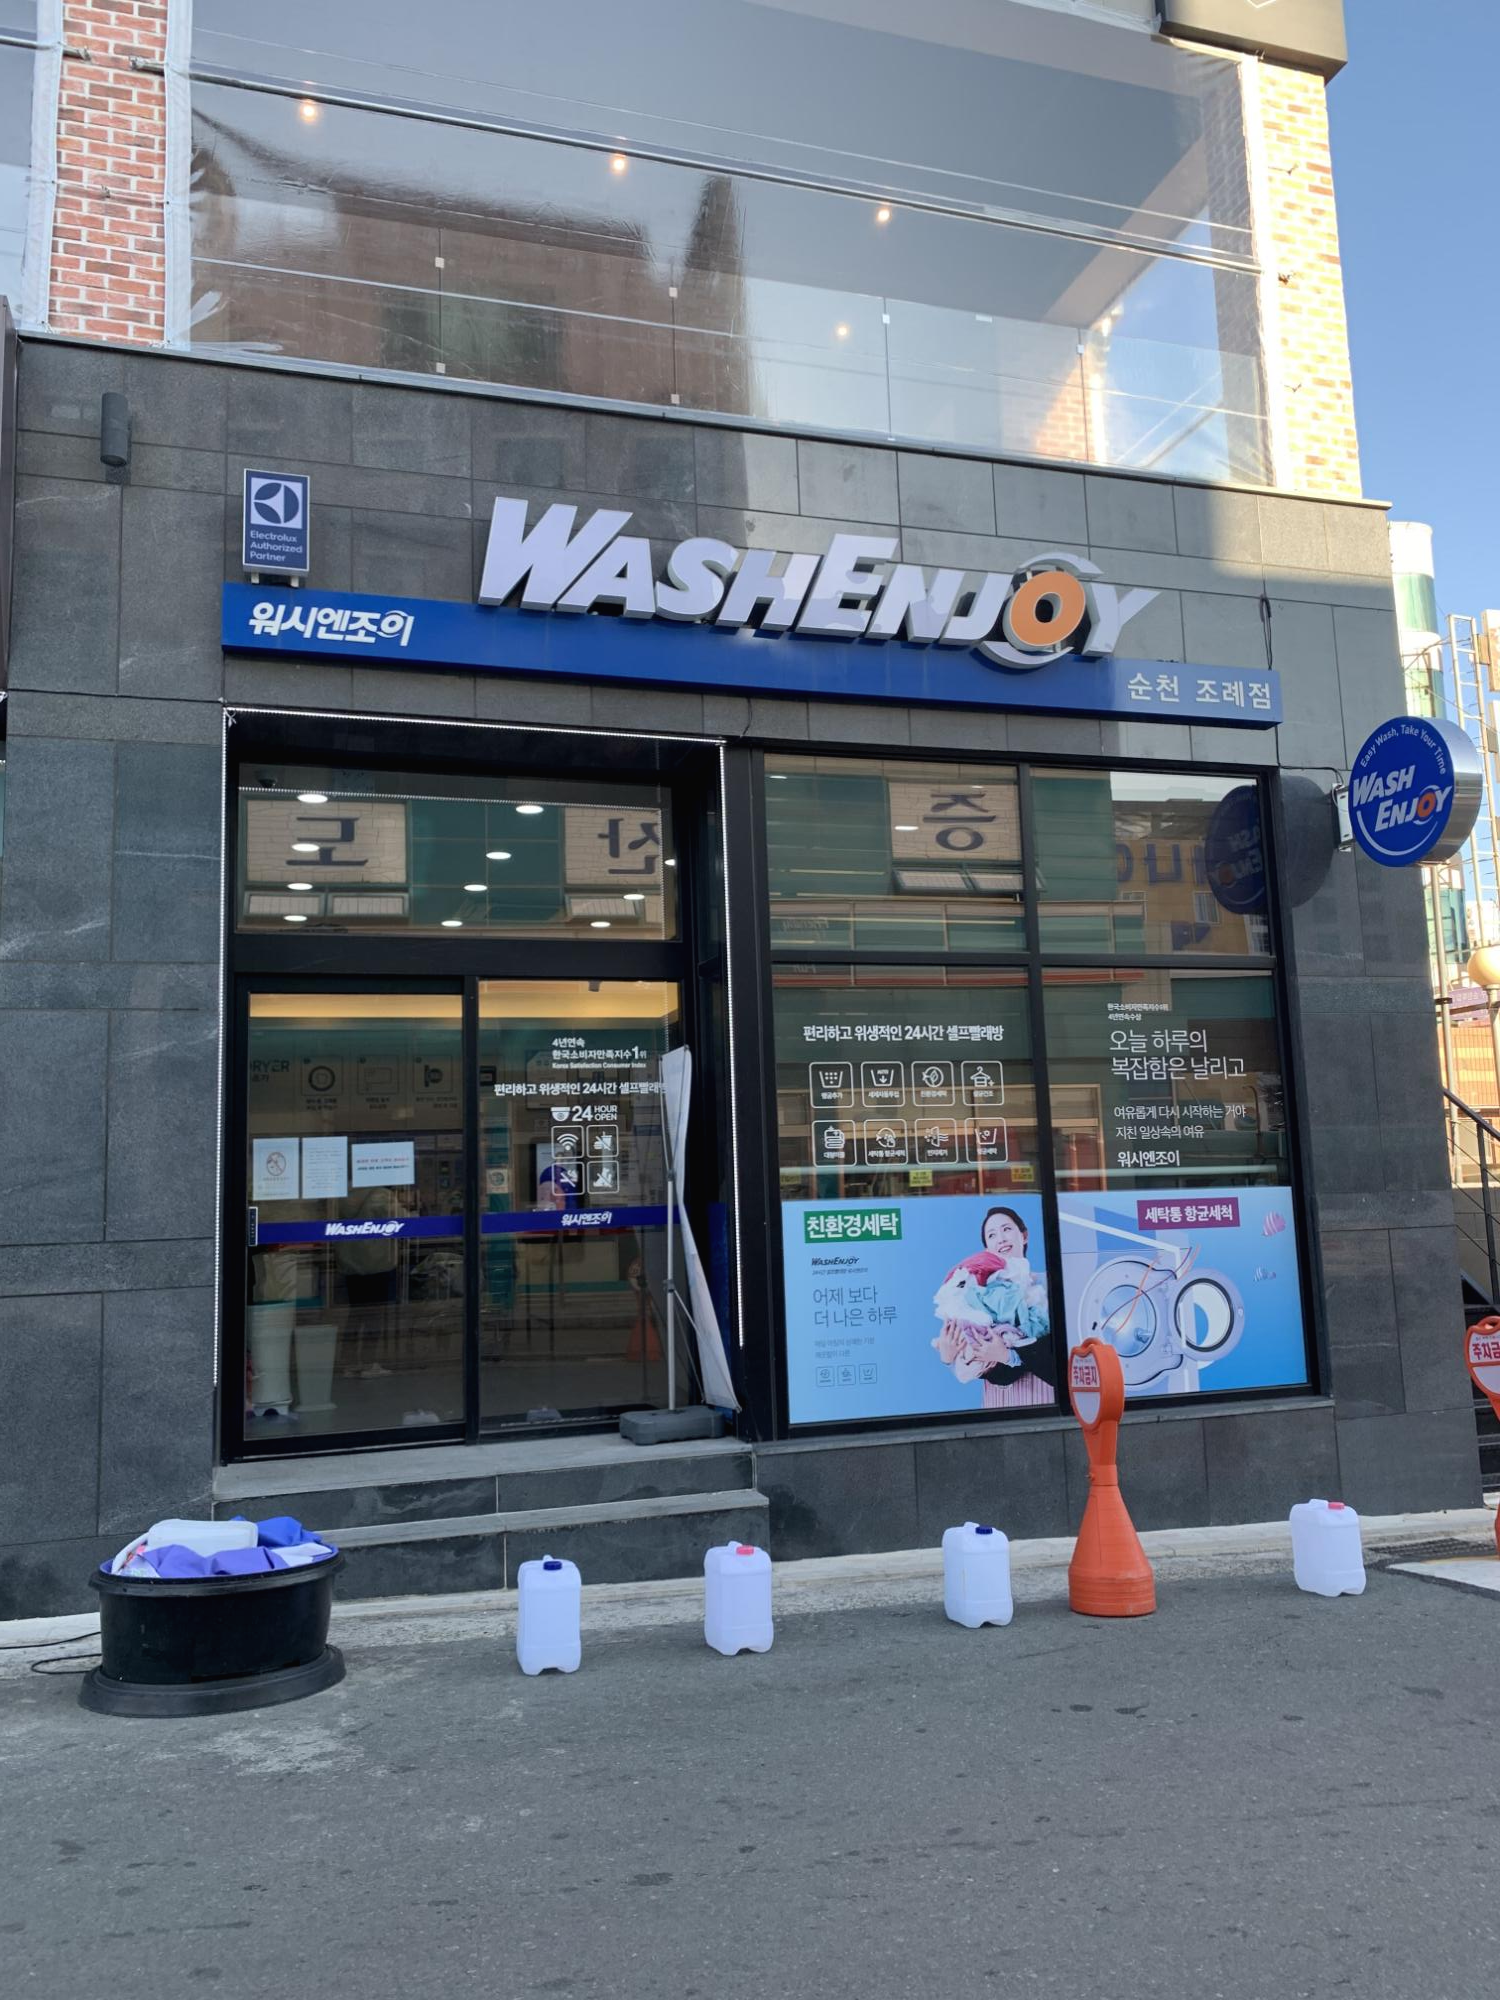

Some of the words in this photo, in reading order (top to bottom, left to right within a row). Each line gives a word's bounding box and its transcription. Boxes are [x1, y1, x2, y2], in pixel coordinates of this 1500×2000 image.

[250, 530, 297, 543] Electrolux
[250, 541, 303, 554] Authorized
[250, 550, 286, 562] Partner
[248, 602, 415, 647] 워시엔조이
[1127, 672, 1181, 704] 순천
[1195, 676, 1272, 711] 조례점
[1360, 744, 1377, 768] Easy
[1374, 727, 1399, 746] Wash,
[1400, 724, 1419, 737] Take
[1420, 728, 1436, 749] Your
[1433, 746, 1447, 775] Time
[1353, 764, 1416, 808] WASH
[1374, 784, 1453, 833] ENJOY
[803, 1025, 853, 1042] 편리하고
[854, 1025, 903, 1042] 위생적인
[904, 1024, 945, 1041] 24시간
[946, 1024, 1004, 1042] 셀프빨래방
[1109, 1029, 1148, 1053] 오늘
[1150, 1028, 1208, 1053] 하루의
[551, 1037, 585, 1048] 4년연속
[551, 1045, 647, 1060] 한국소비자만족지수1위
[1111, 1056, 1188, 1081] 복잡함은
[1190, 1056, 1247, 1080] 날리고
[493, 1083, 537, 1096] 편리하고
[538, 1082, 580, 1095] 위생적인
[582, 1081, 617, 1095] 24시간
[571, 1105, 594, 1122] 24
[594, 1105, 618, 1113] HOUR
[594, 1113, 618, 1121] OPEN
[1114, 1105, 1157, 1120] 여유롭게
[1158, 1105, 1180, 1119] 다시
[1182, 1104, 1224, 1119] 시작하는
[1224, 1104, 1247, 1119] 거야
[1115, 1126, 1137, 1140] 지친
[1138, 1125, 1182, 1140] 일상속의
[1183, 1125, 1205, 1139] 여유
[1117, 1150, 1180, 1167] 워시엔조이
[560, 1211, 613, 1227] 워시엔조이
[1144, 1206, 1183, 1224] 세탁통
[1183, 1204, 1234, 1223] 항균세척
[806, 1213, 899, 1239] 친환경세탁
[813, 1287, 844, 1306] 어제
[847, 1285, 878, 1304] 보다
[814, 1310, 830, 1328] 더
[833, 1307, 863, 1327] 나은
[867, 1305, 898, 1326] 하루
[1072, 1365, 1098, 1386] 주차금지
